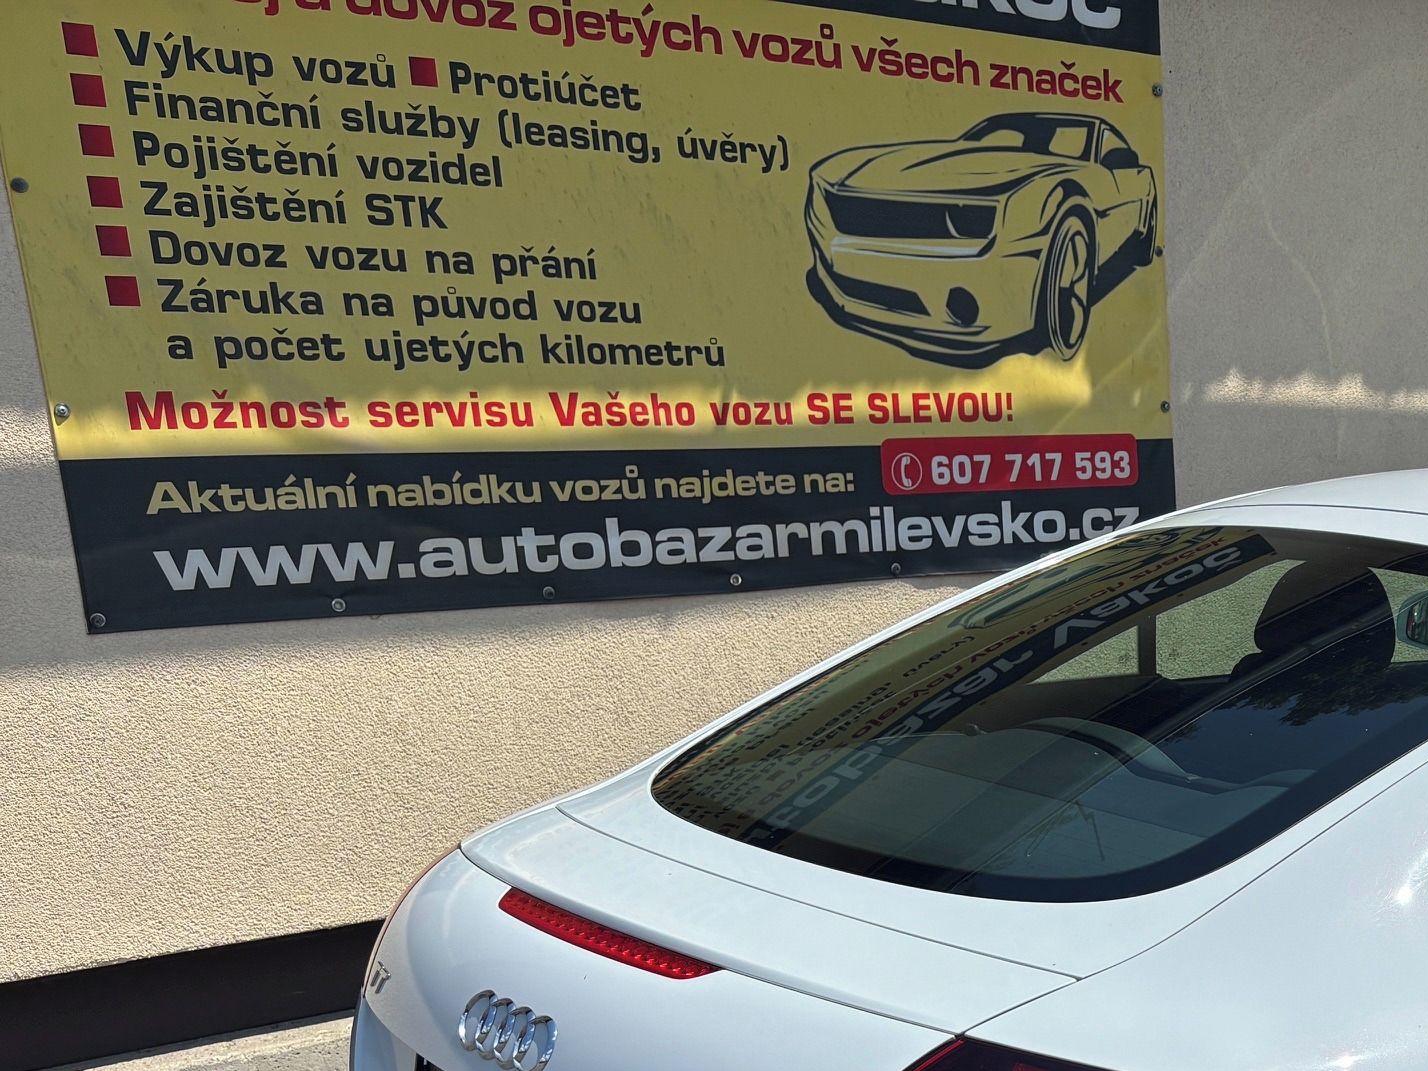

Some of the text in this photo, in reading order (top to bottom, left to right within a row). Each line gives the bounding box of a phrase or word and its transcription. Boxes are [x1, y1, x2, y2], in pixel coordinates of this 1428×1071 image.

[114, 29, 641, 111] Výkup vozů Protiúčet
[529, 0, 721, 57] ojetých
[733, 24, 842, 68] vozů
[851, 36, 980, 86] všech
[990, 60, 1124, 103] značek
[124, 80, 788, 173] Finanční služby (leasing, úvěry)
[133, 131, 502, 187] Pojištění vozidel
[140, 181, 448, 229] Zajištění STK
[149, 230, 596, 284] Dovoz vozu na přání
[157, 277, 641, 326] Záruka na původ vozu
[167, 328, 725, 371] a počet ujetých kilometrů
[125, 391, 1013, 430] Možnost servisu Vašeho vozu SE SLEVOU!
[147, 466, 855, 514] Aktuální nabídku vozů najdete na:
[932, 451, 1130, 484] 607 717 593
[153, 501, 1140, 591] www.autobazarmilevsko.cz
